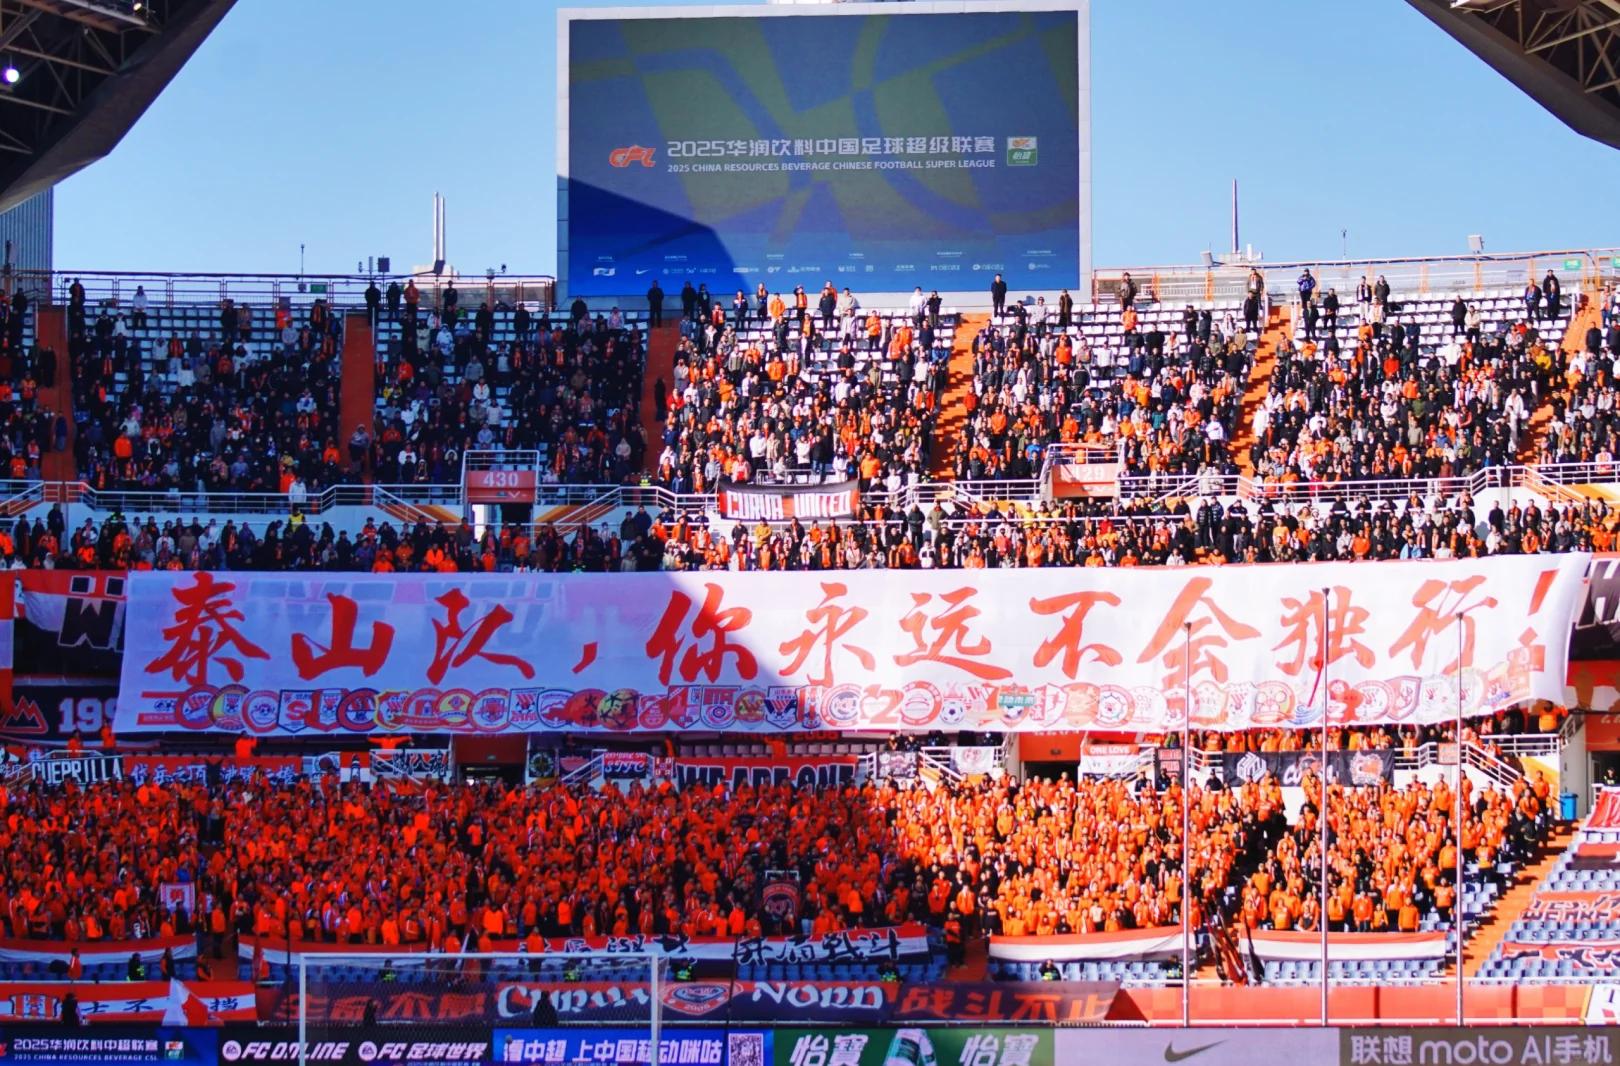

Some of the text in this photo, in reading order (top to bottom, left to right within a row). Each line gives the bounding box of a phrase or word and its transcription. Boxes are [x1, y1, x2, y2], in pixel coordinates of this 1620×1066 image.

[667, 136, 995, 157] 2025华润饮料中国足球超级联赛
[667, 159, 995, 173] 2025 CHINA RESOURCES BEVERAGE CHINESE FOOTBALL SUPER LEAGUE
[483, 472, 519, 487] 430
[726, 490, 852, 520] CURVA UNITED
[81, 997, 239, 1014] 士不挡
[13, 1038, 158, 1051] 2025华润饮料中超联赛
[241, 1042, 272, 1060] FC
[376, 1043, 404, 1060] FC
[406, 1043, 488, 1060] 足球世界
[1350, 1034, 1613, 1065] 联想 moto AI手机
